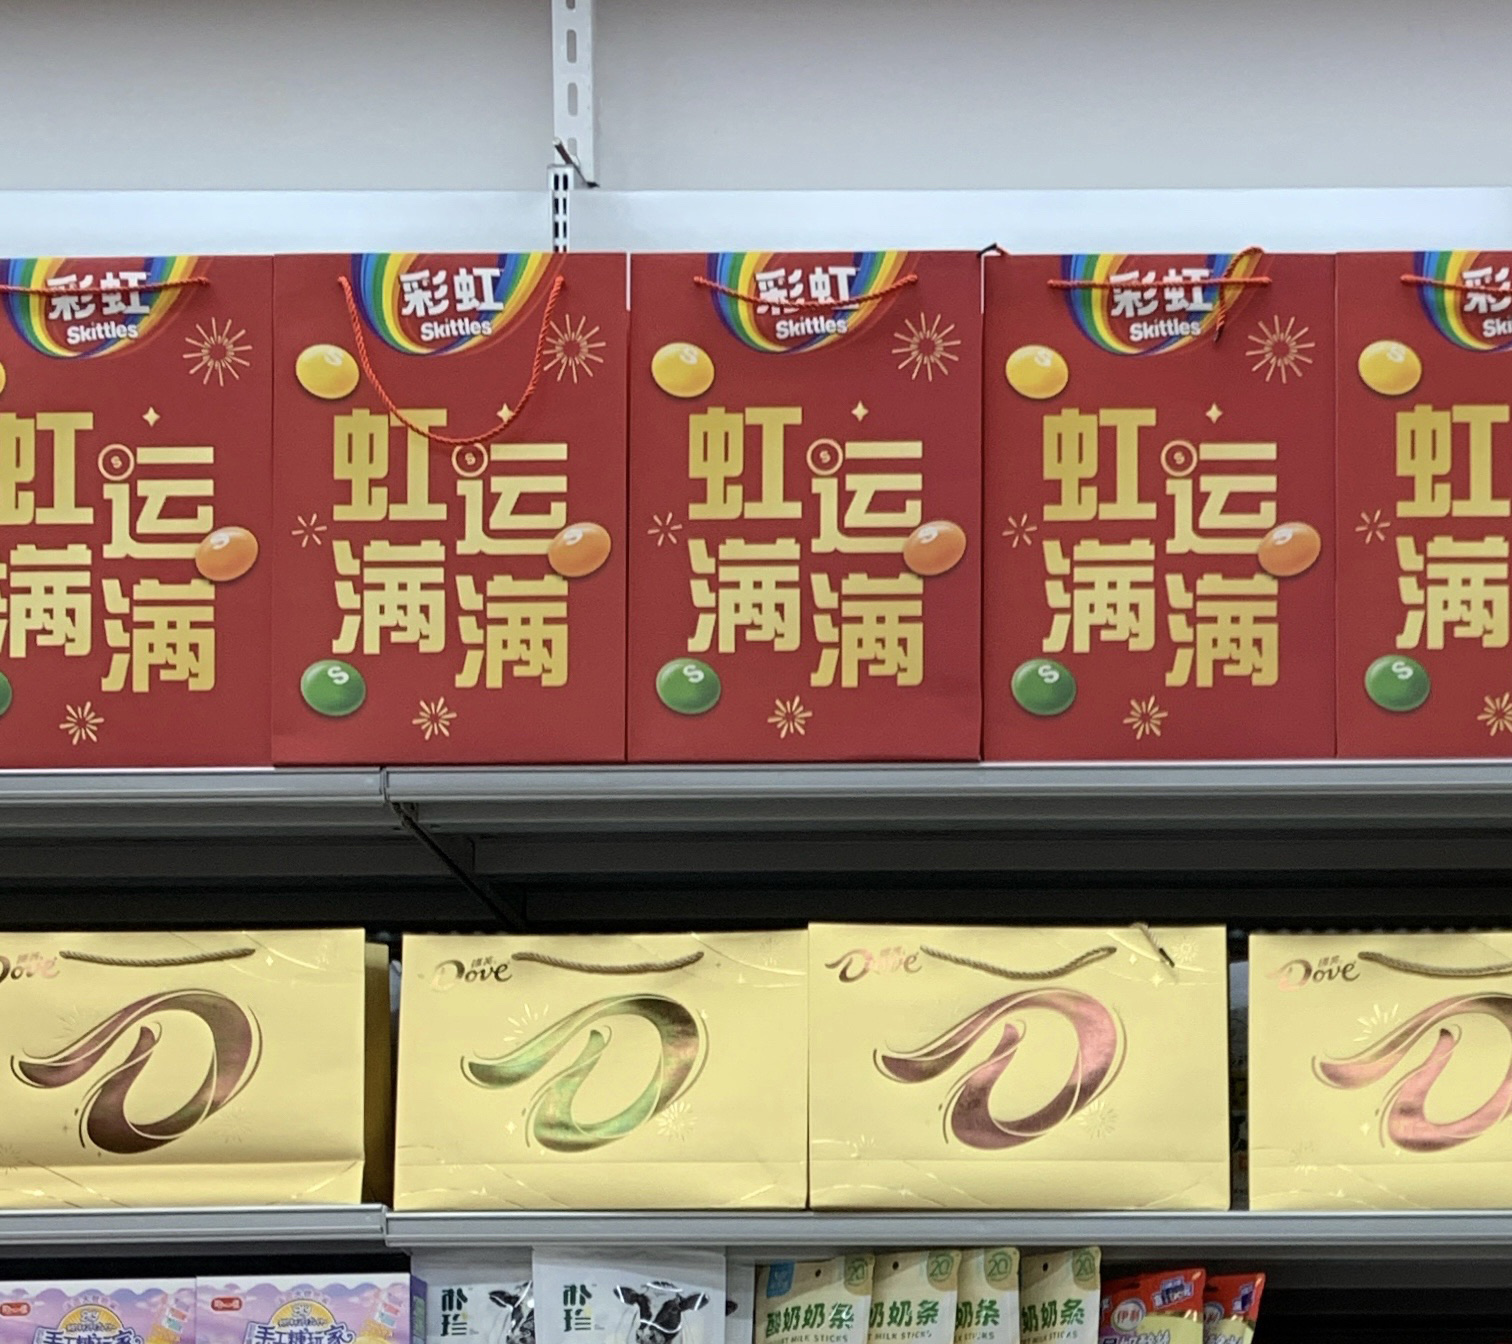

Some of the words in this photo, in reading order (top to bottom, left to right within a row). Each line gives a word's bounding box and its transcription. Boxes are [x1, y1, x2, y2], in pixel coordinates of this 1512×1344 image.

[48, 266, 151, 318] 彩虹
[400, 266, 504, 318] 彩虹
[755, 266, 858, 318] 彩虹
[1110, 267, 1214, 318] 彩虹
[66, 320, 138, 344] Skittles
[420, 316, 492, 342] Skittles
[776, 314, 848, 339] Skittles
[1129, 316, 1201, 342] Skittles
[766, 1303, 855, 1337] 酸奶奶条
